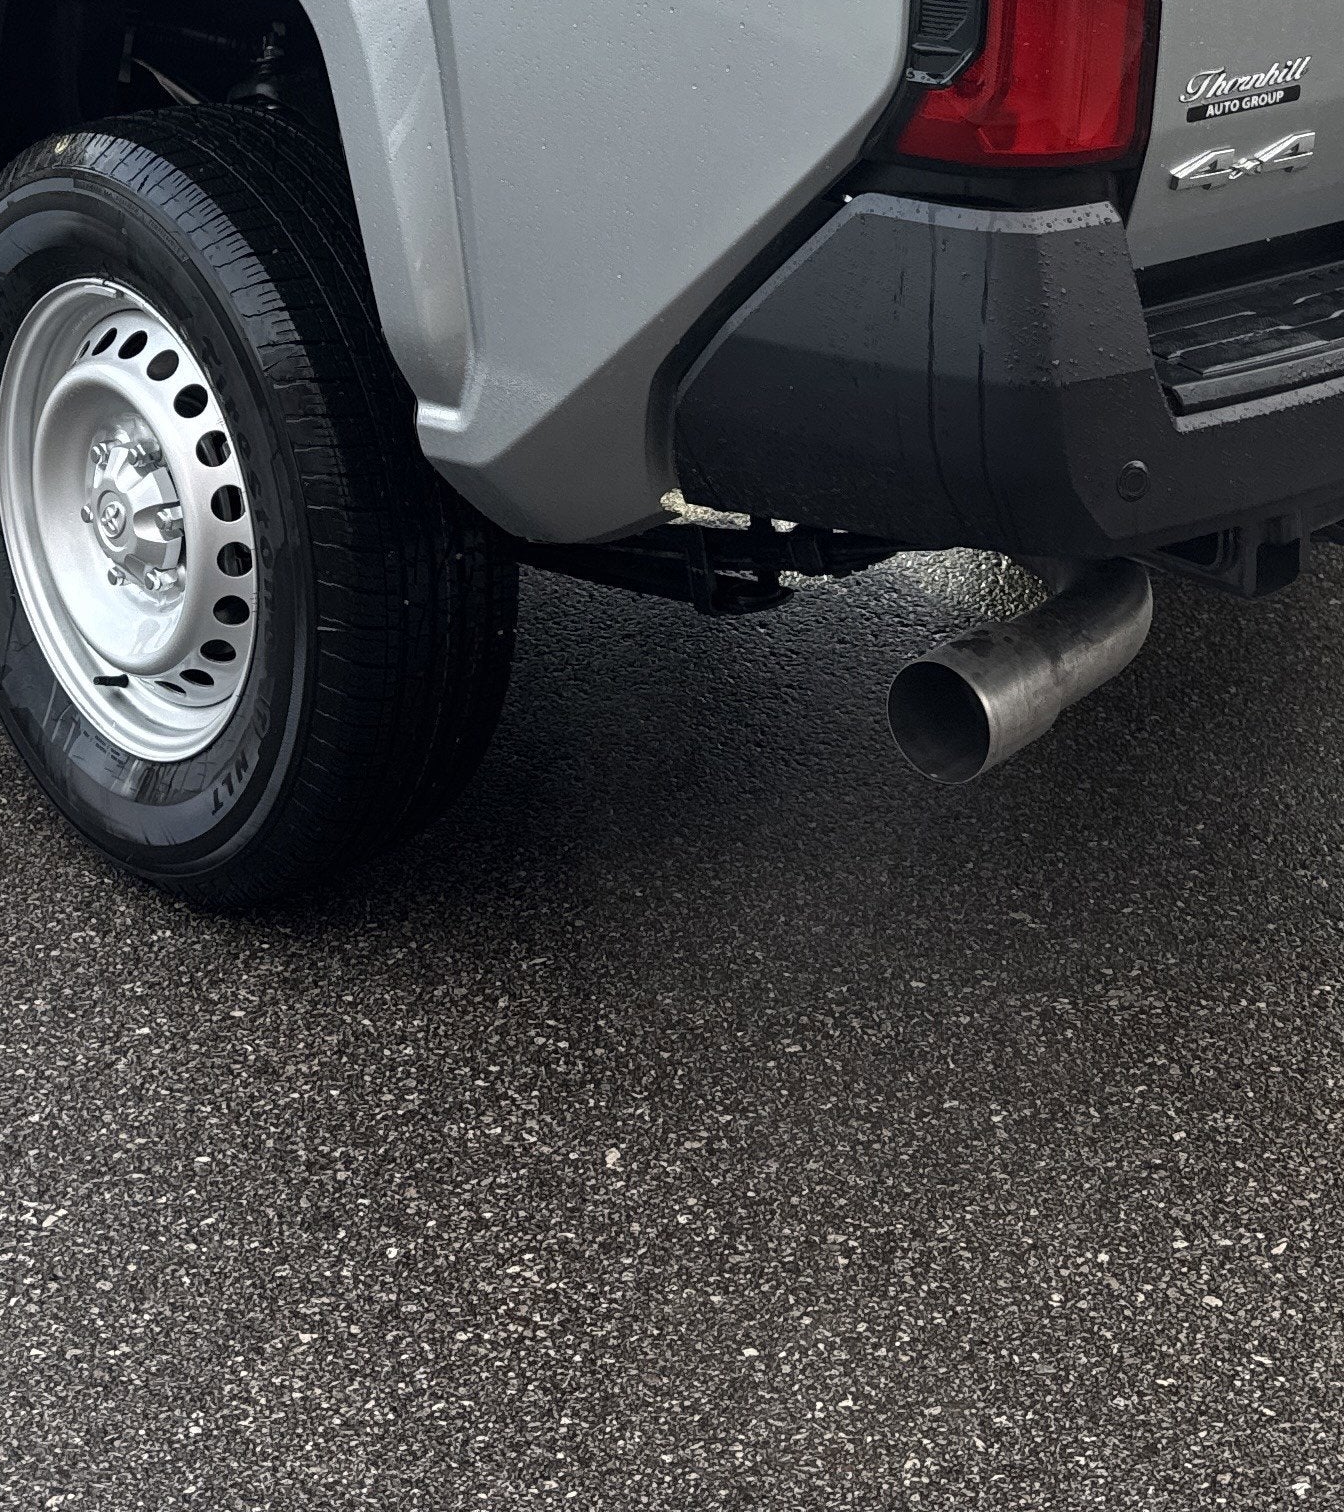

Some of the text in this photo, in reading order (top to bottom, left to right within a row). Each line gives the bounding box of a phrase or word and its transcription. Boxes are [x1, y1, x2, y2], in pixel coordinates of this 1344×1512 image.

[1179, 55, 1312, 103] Thornhill
[1205, 90, 1285, 118] AUTO GROUP
